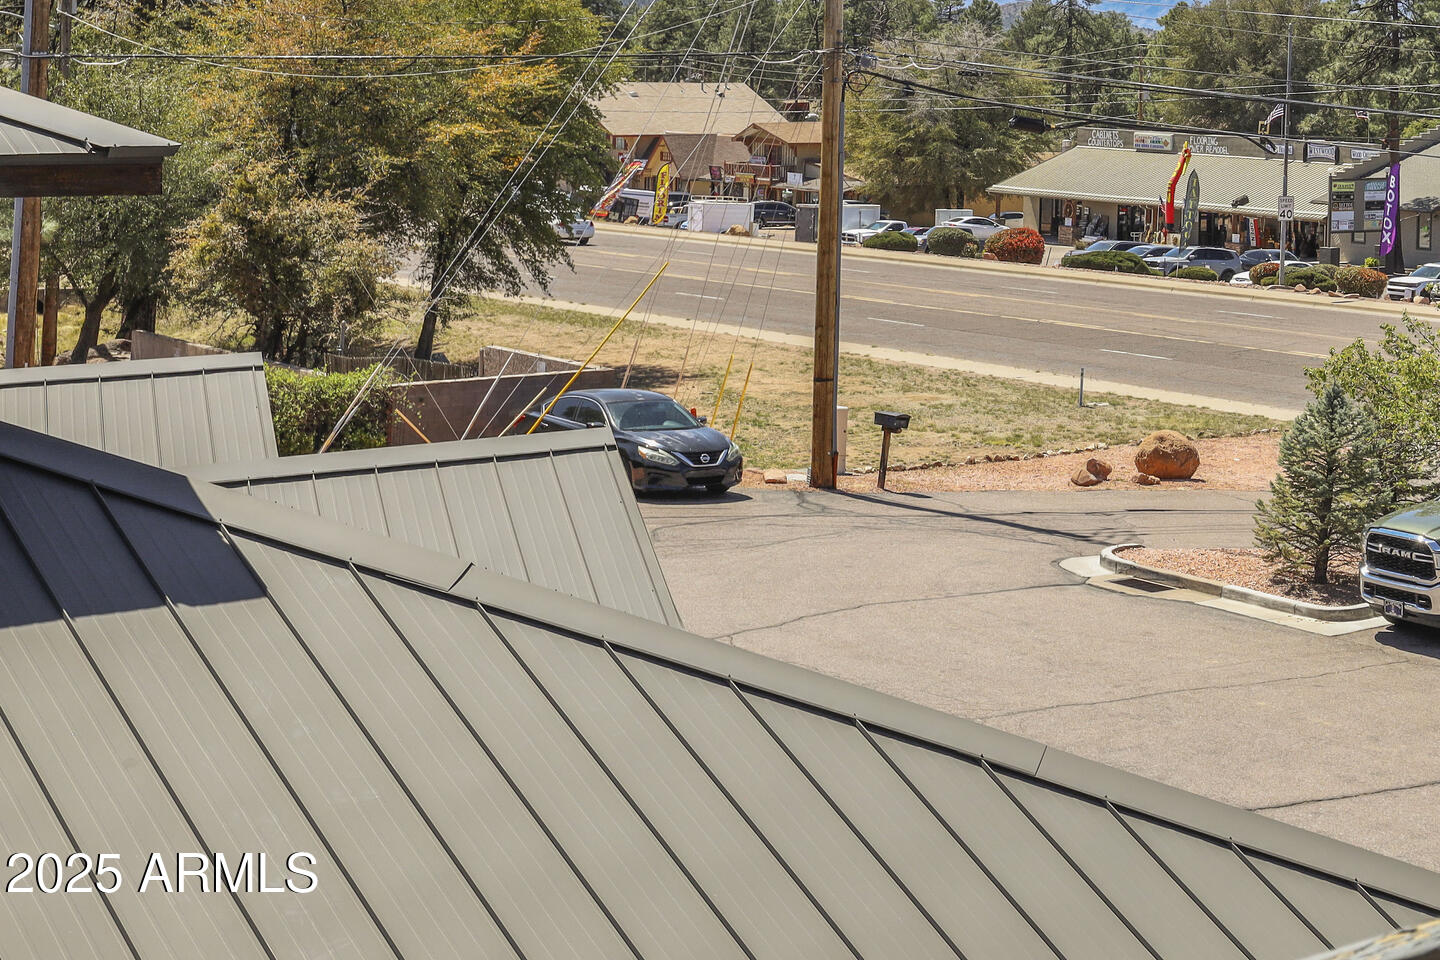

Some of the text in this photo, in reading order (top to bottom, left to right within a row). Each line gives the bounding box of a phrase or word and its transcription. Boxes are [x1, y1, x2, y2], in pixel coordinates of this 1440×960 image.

[1091, 129, 1119, 140] CABINETS
[1087, 137, 1124, 148] COUNTERTOPS
[1189, 135, 1219, 146] FLOORING
[1205, 145, 1229, 155] REMODEL
[1279, 209, 1293, 219] 40
[1381, 175, 1396, 244] BOTOX
[1382, 546, 1413, 559] RAM
